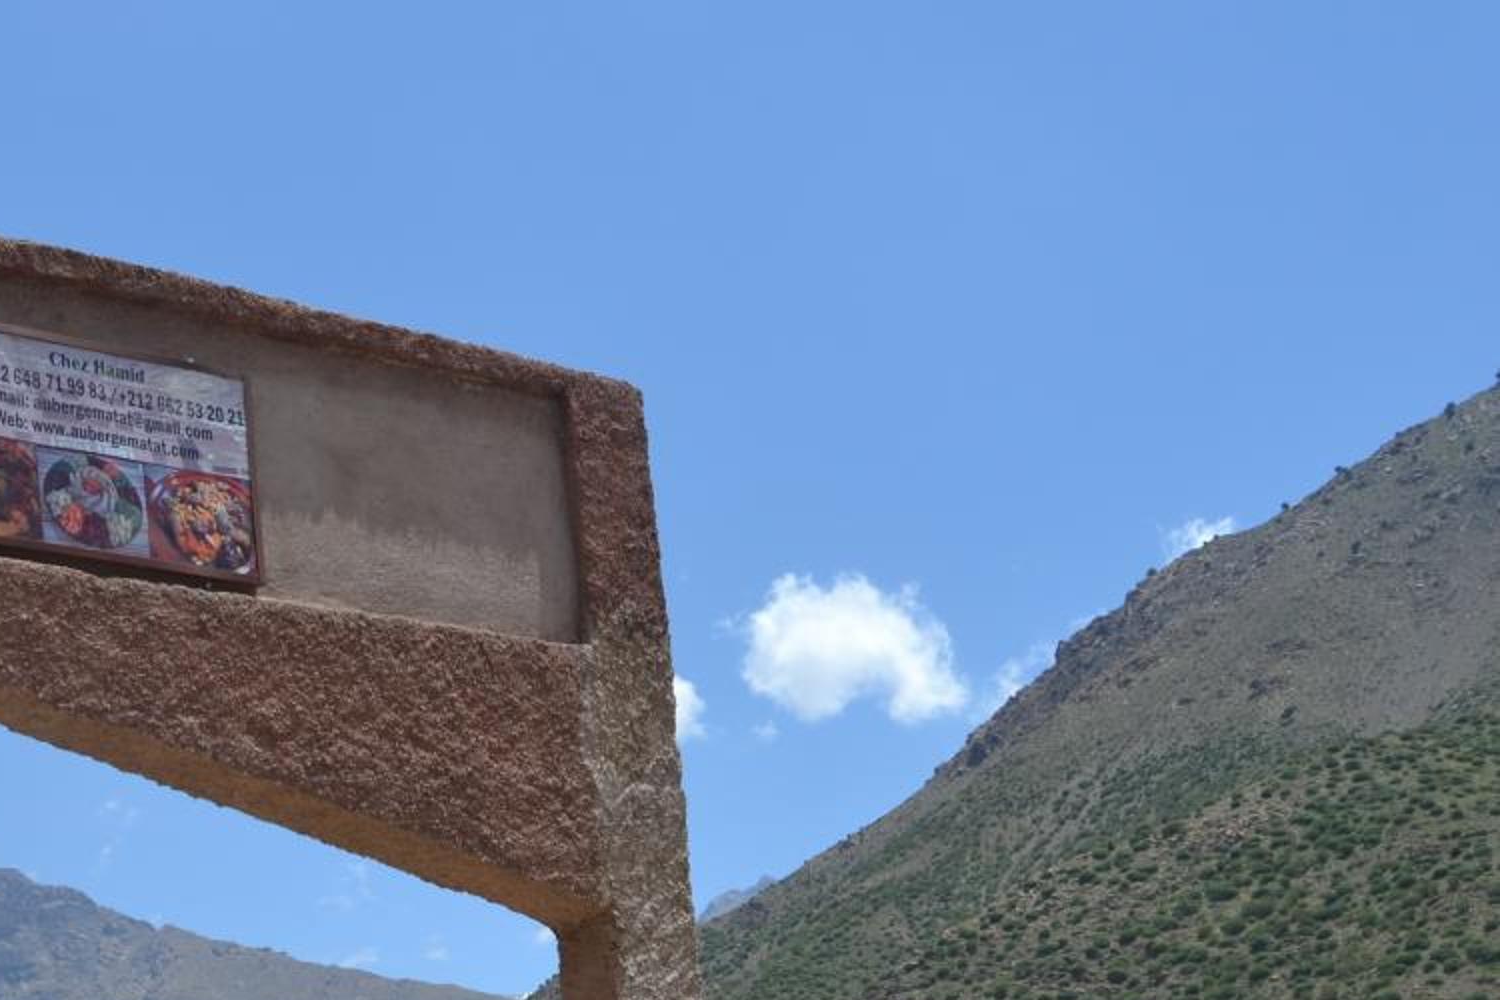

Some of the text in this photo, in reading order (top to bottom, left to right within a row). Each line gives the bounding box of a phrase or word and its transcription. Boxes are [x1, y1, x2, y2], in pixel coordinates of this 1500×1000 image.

[50, 351, 145, 383] Chez Hamid
[13, 368, 41, 390] 648
[187, 400, 203, 419] 53
[227, 408, 244, 427] 21
[32, 419, 199, 460] www.aubergematat.com
